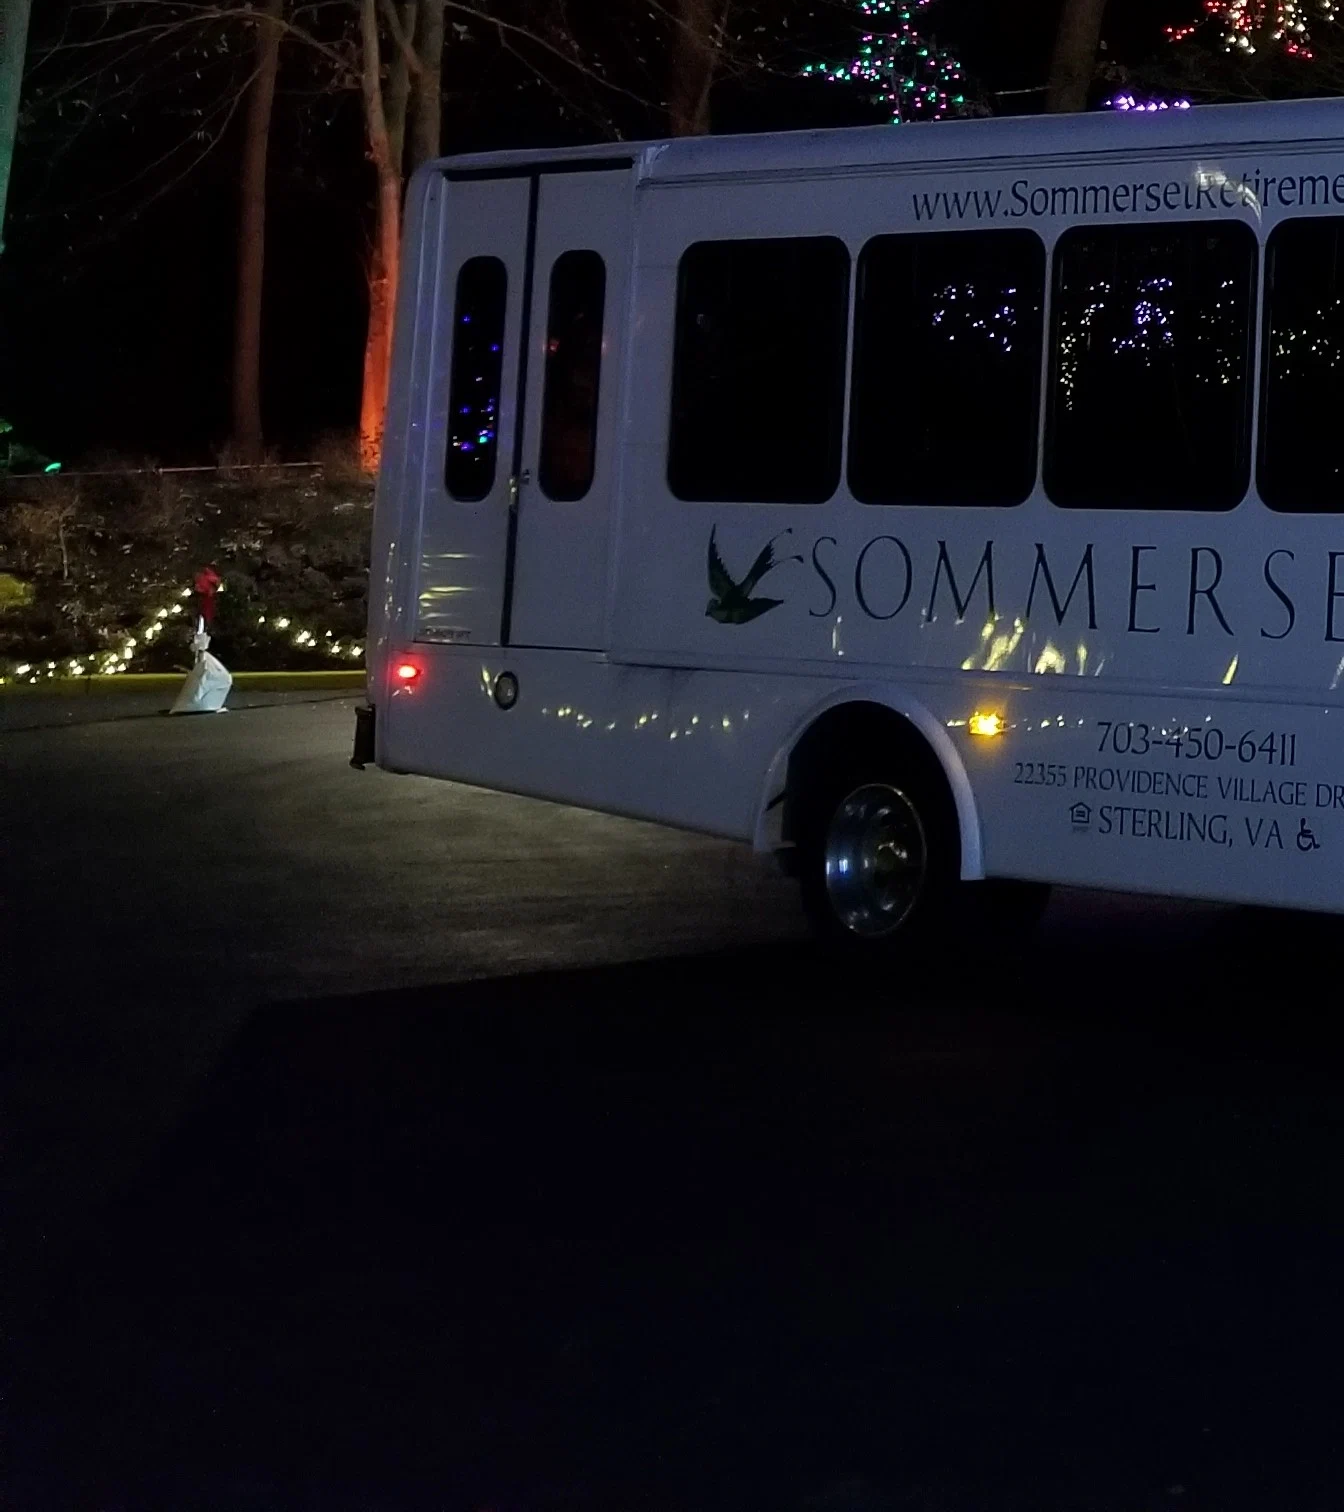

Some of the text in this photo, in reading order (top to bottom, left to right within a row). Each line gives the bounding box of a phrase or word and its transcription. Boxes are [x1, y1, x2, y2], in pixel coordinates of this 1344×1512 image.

[1097, 720, 1297, 767] 703-450-6411
[1013, 761, 1067, 788] 22355
[1073, 765, 1209, 800] PROVIDENCE
[1217, 775, 1308, 807] VILLAGE
[1099, 805, 1284, 850] STERLING, VA
